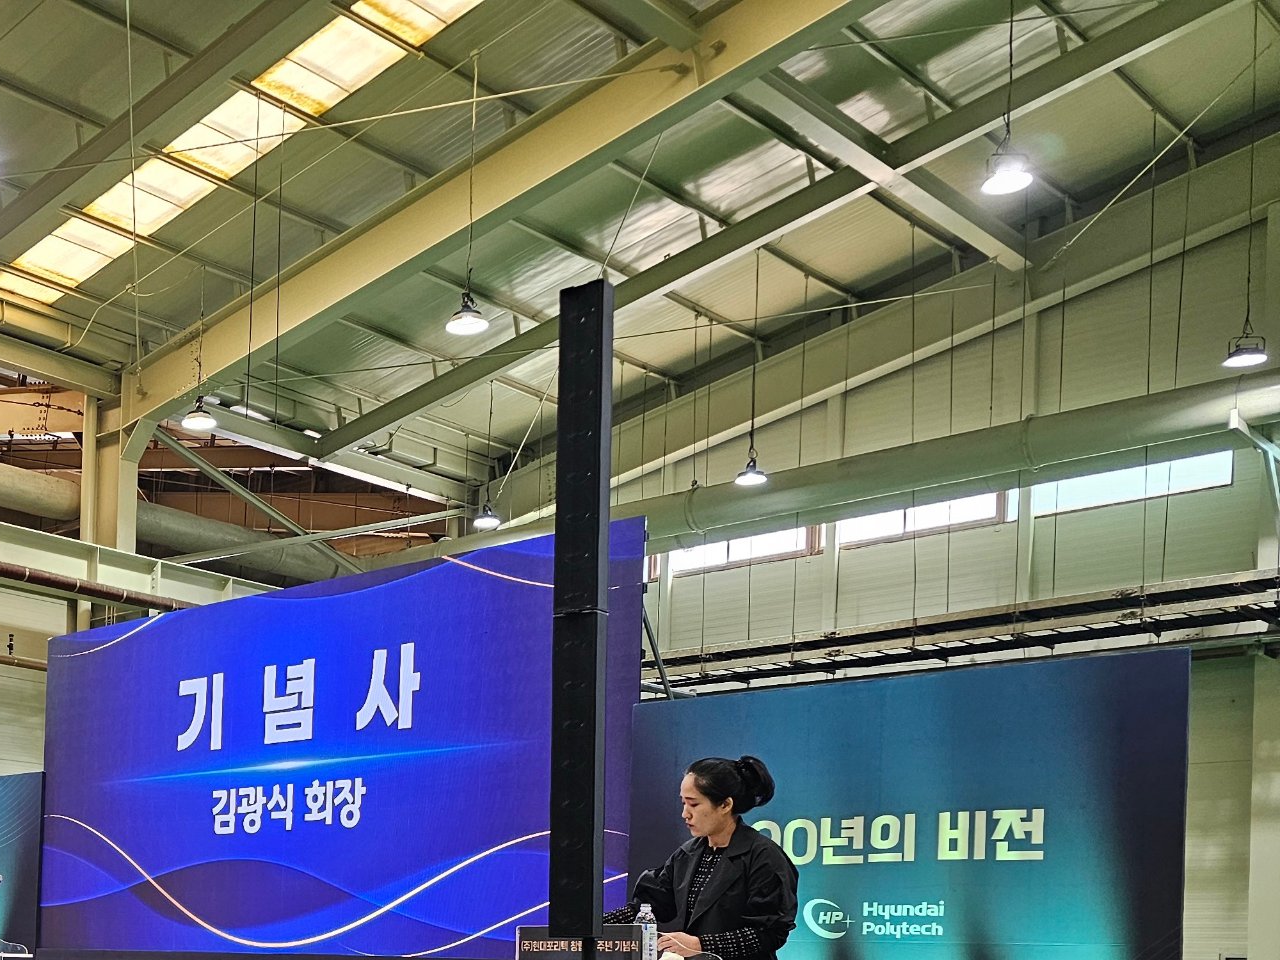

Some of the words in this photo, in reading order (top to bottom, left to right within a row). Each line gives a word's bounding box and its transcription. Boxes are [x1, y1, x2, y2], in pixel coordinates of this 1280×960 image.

[212, 784, 294, 835] 김광식
[304, 777, 366, 828] 회장
[937, 808, 1045, 861] 비전
[862, 900, 945, 919] Hyundai
[862, 921, 944, 938] Polytech
[521, 940, 569, 952] (주)현대포리텍
[596, 940, 613, 952] 주년
[614, 940, 640, 953] 기념식
